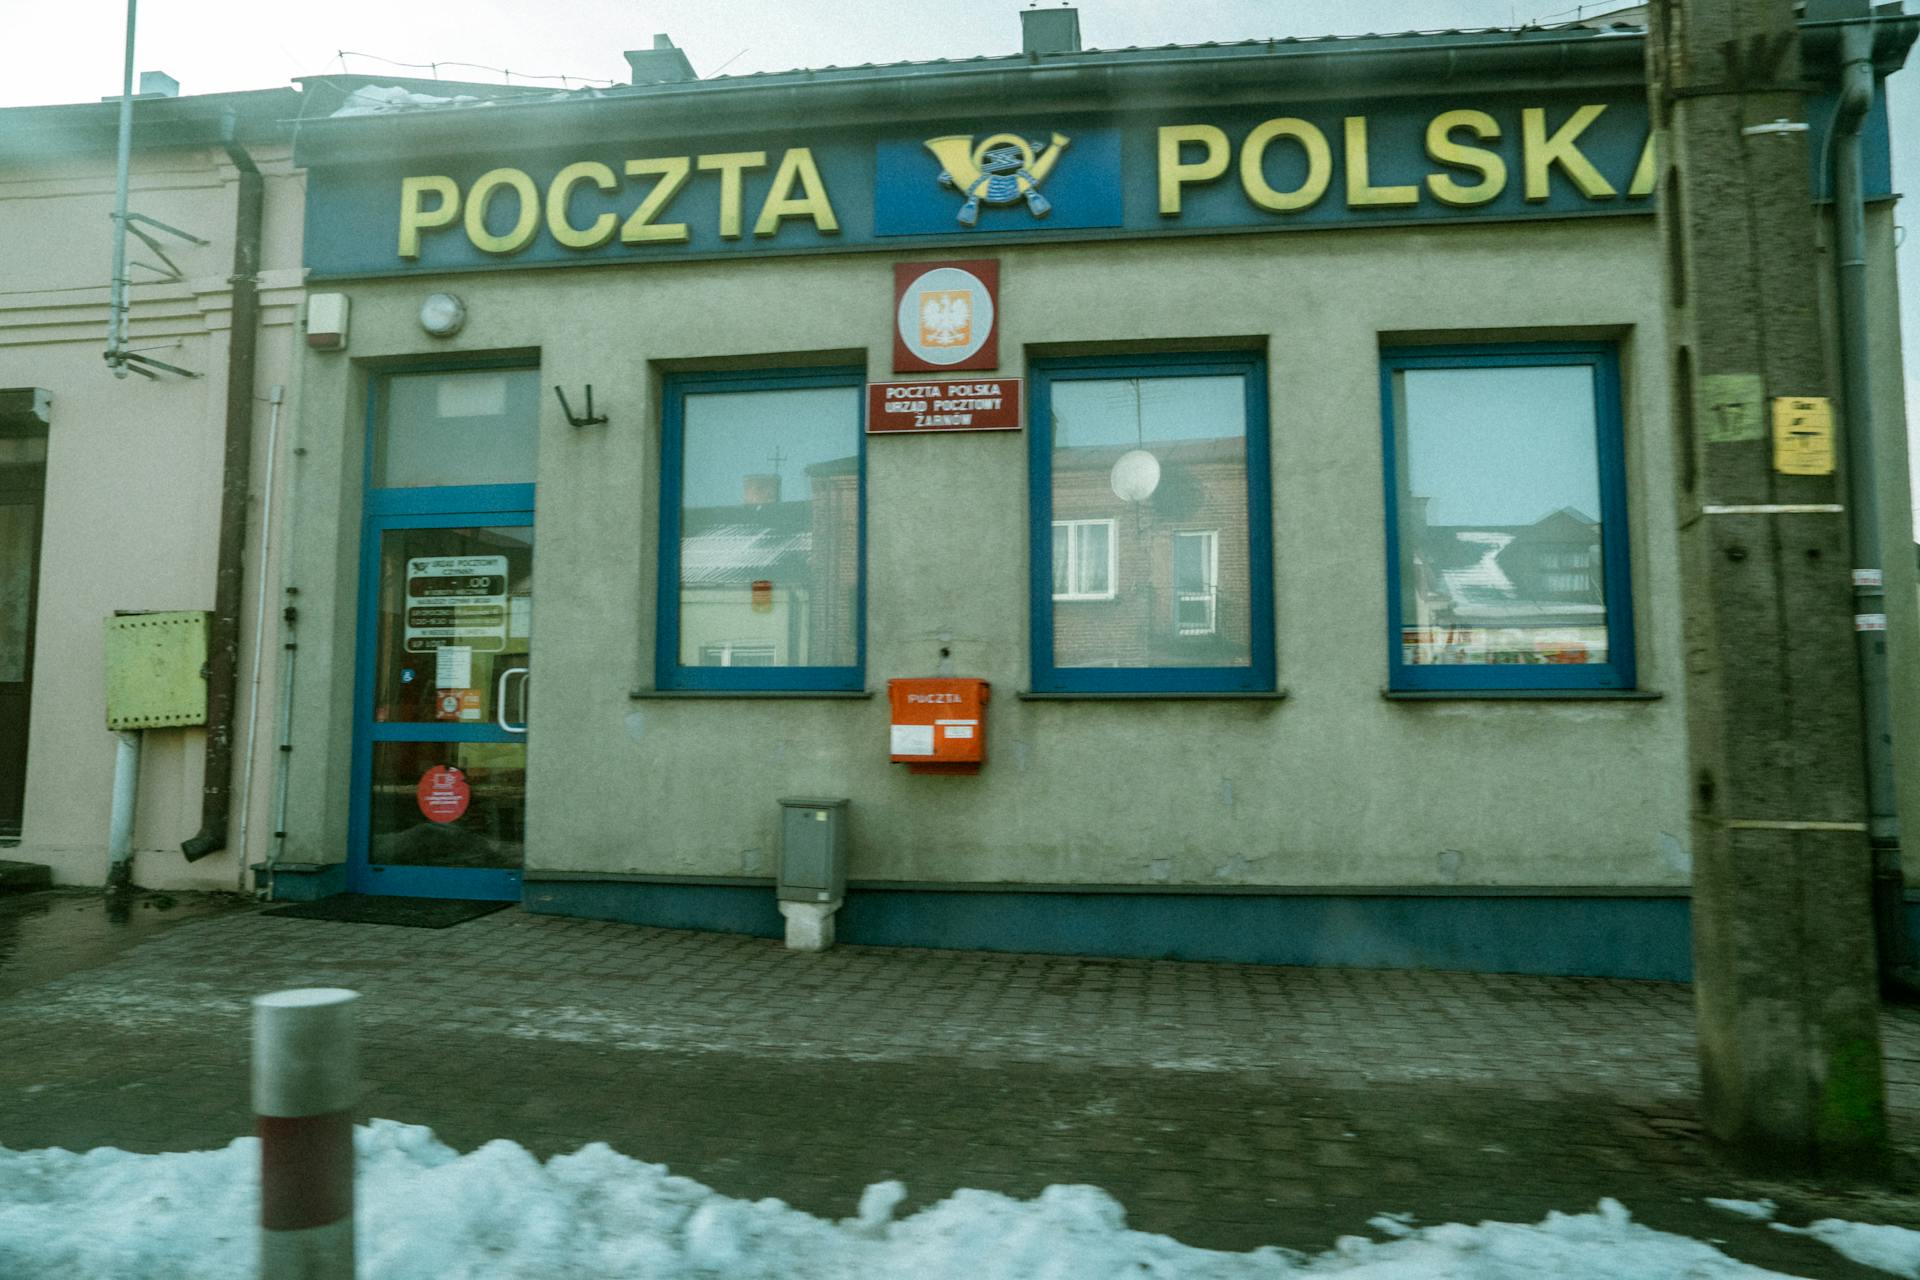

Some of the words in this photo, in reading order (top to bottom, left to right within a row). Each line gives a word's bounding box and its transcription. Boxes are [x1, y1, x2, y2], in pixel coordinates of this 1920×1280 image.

[398, 147, 839, 259] POCZTA
[886, 386, 941, 399] POCZTA
[948, 384, 1001, 396] POLSKA
[933, 399, 1002, 411] POCZTOWY
[908, 693, 962, 704] POCZTA
